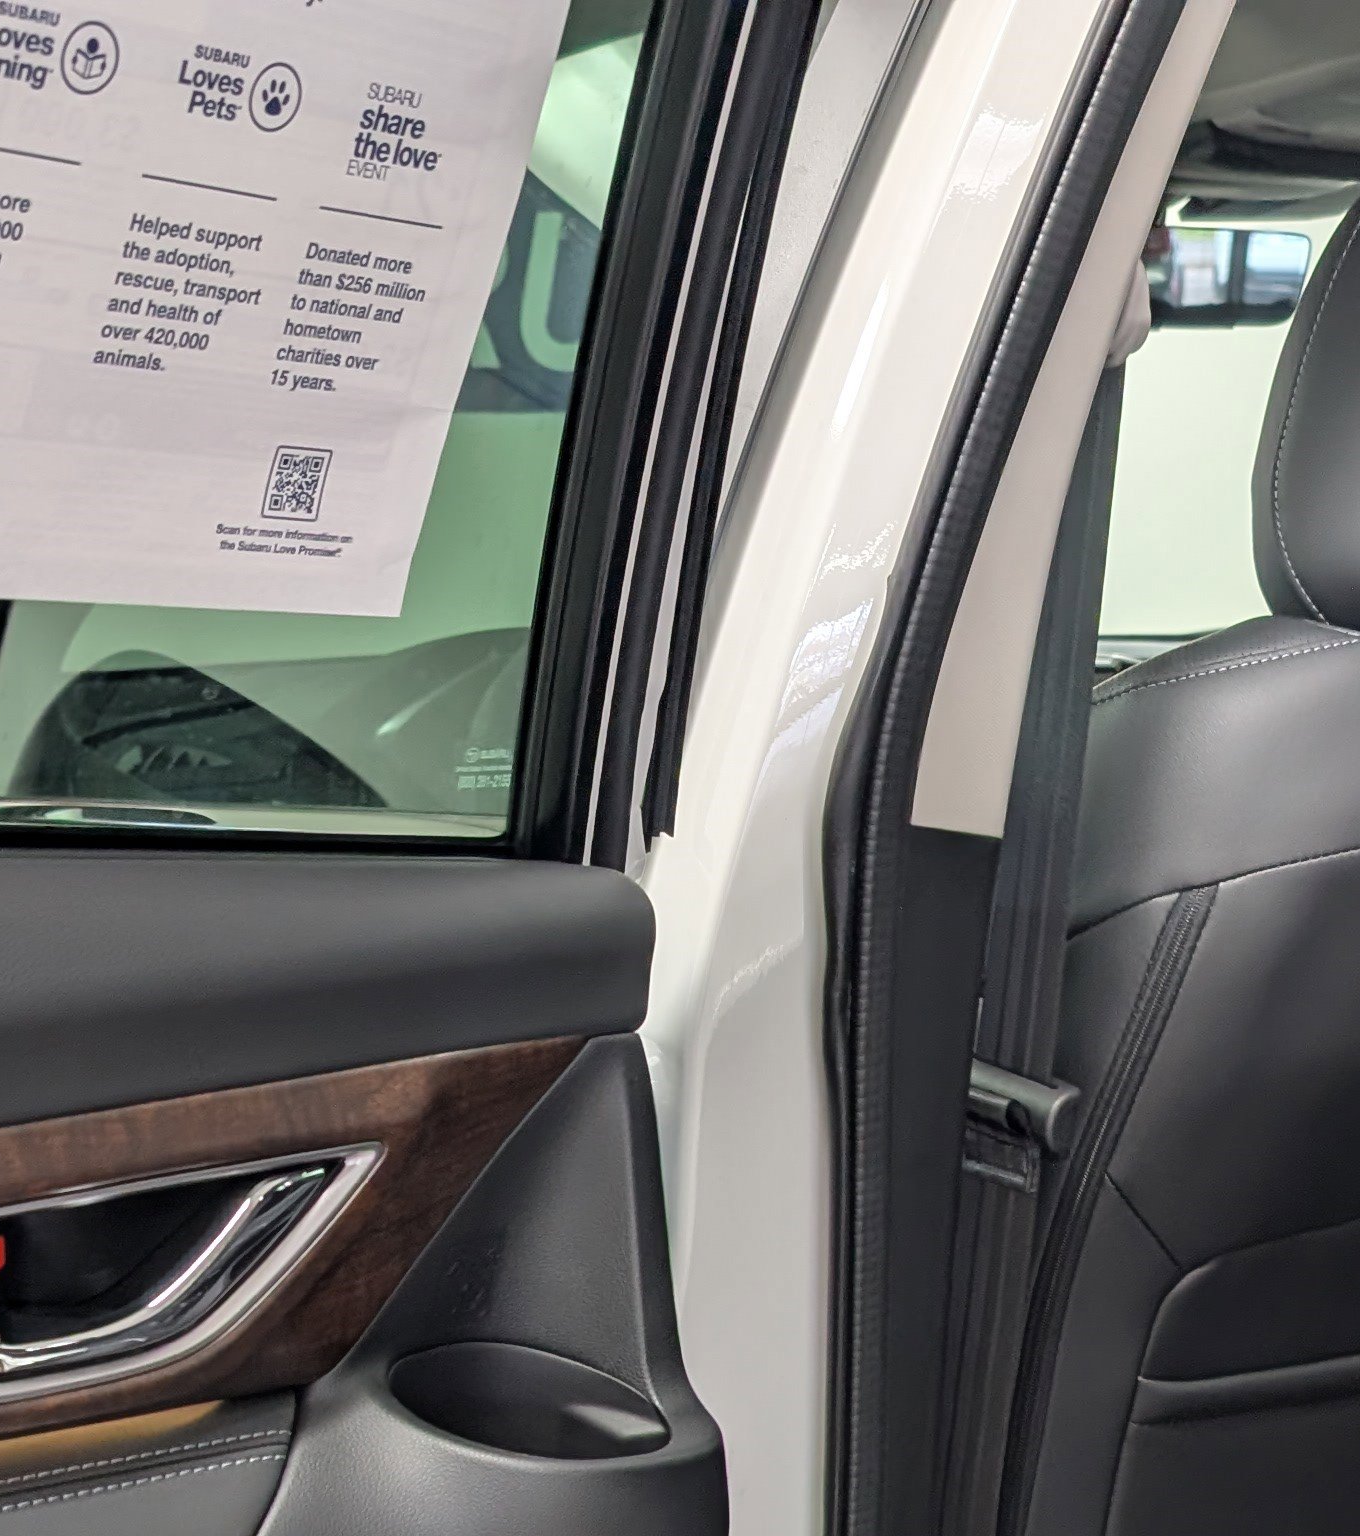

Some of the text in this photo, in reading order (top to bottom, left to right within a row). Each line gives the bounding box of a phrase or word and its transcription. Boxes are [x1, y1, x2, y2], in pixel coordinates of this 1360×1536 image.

[194, 44, 252, 69] SUBARU
[177, 59, 245, 97] Loves
[367, 81, 423, 110] SUBARU
[358, 104, 426, 140] share
[353, 131, 390, 163] the
[345, 158, 391, 183] EVENT
[128, 212, 264, 252] Helped support
[121, 240, 235, 279] the adoption,
[305, 241, 414, 275] Donated more
[114, 271, 262, 306] rescue, transport
[296, 268, 426, 303] than $256 million
[106, 297, 223, 327] and health of
[289, 293, 405, 324] to national and
[100, 324, 210, 351] over 420,000
[282, 317, 363, 344] hometown
[92, 348, 166, 372] animals.
[276, 344, 380, 371] charities over
[270, 368, 337, 392] 15 years.
[216, 523, 240, 535] Scan
[242, 525, 256, 536] for
[258, 528, 283, 539] more
[220, 540, 235, 551] the
[237, 541, 272, 553] Subaru
[274, 543, 296, 555] Love
